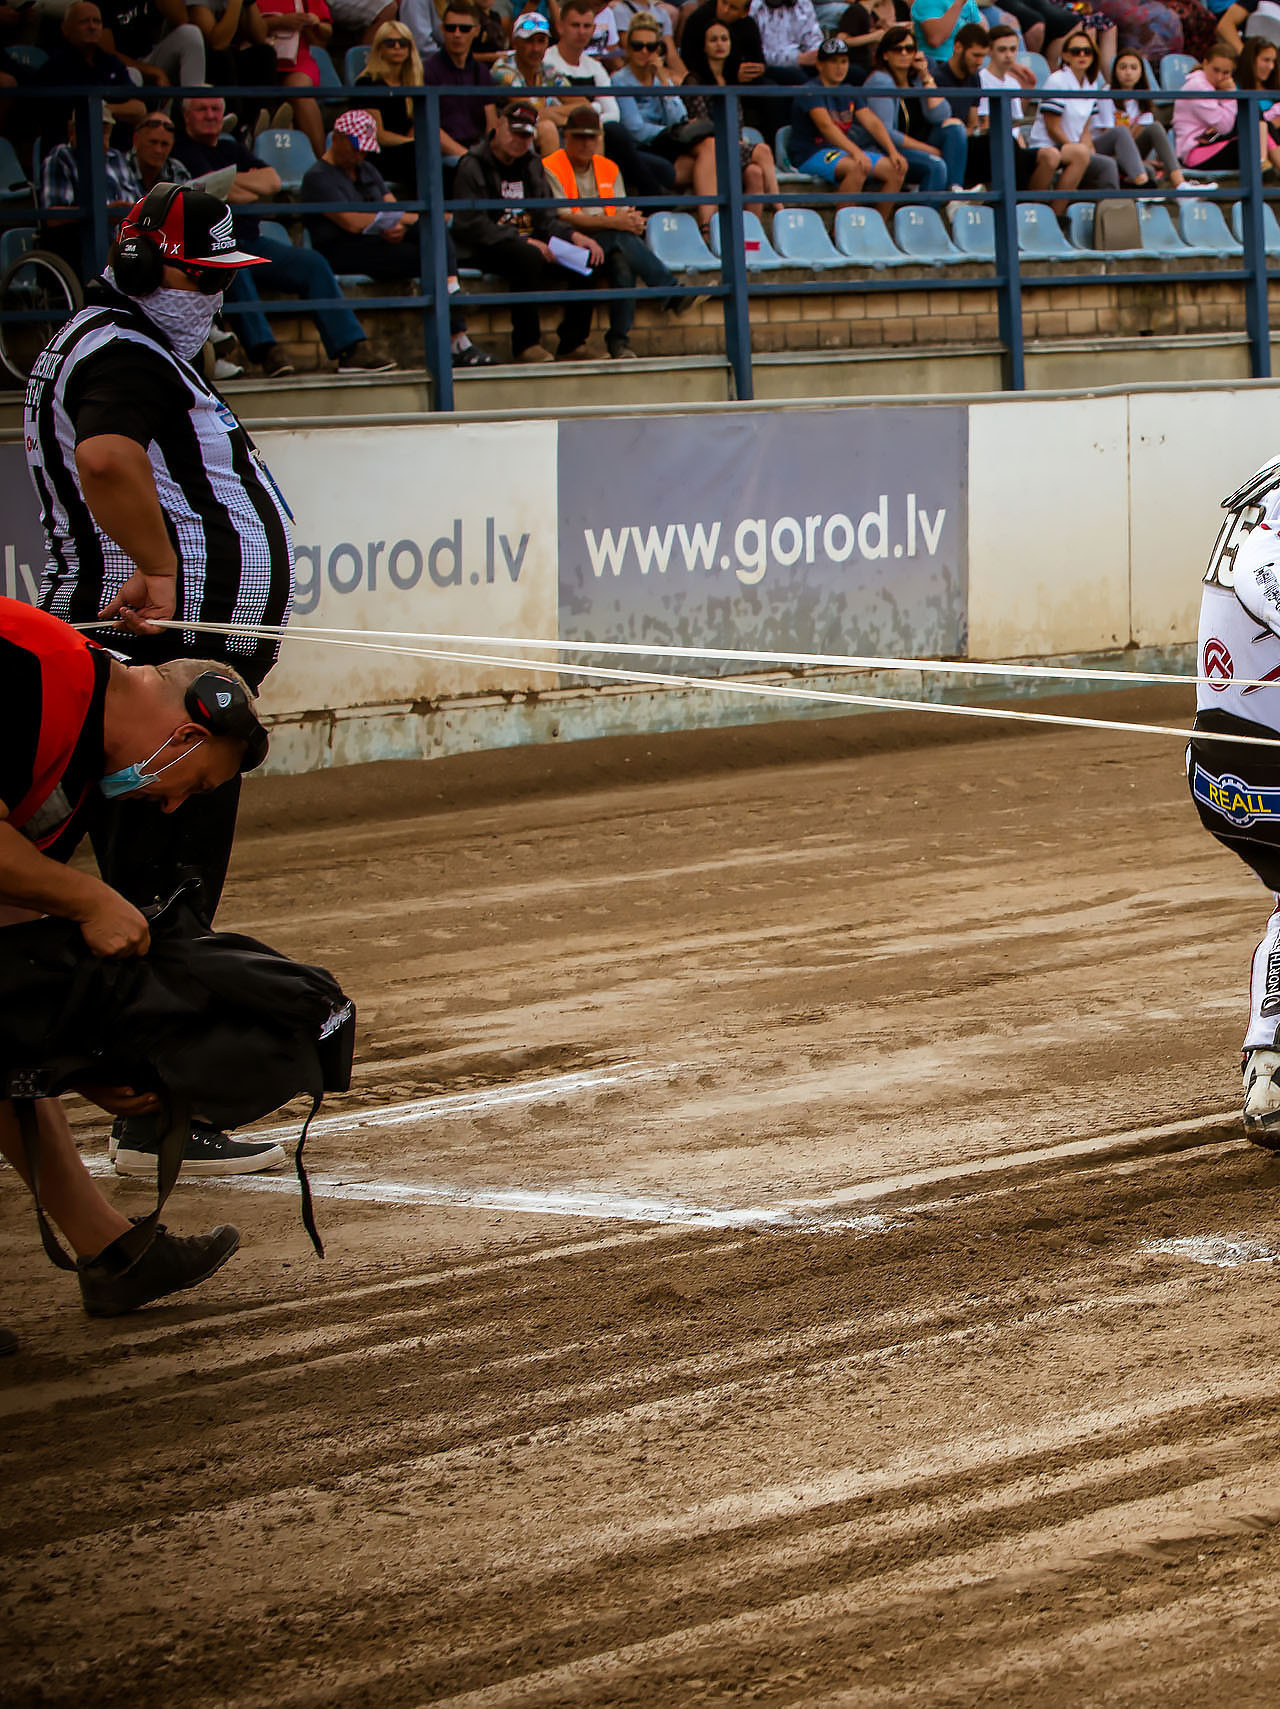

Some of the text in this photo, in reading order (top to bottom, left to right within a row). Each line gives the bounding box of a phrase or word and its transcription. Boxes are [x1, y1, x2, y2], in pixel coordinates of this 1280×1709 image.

[274, 133, 292, 149] 22
[124, 244, 137, 252] 3M
[583, 493, 947, 585] www.gorod.lv
[1208, 781, 1273, 814] REALL
